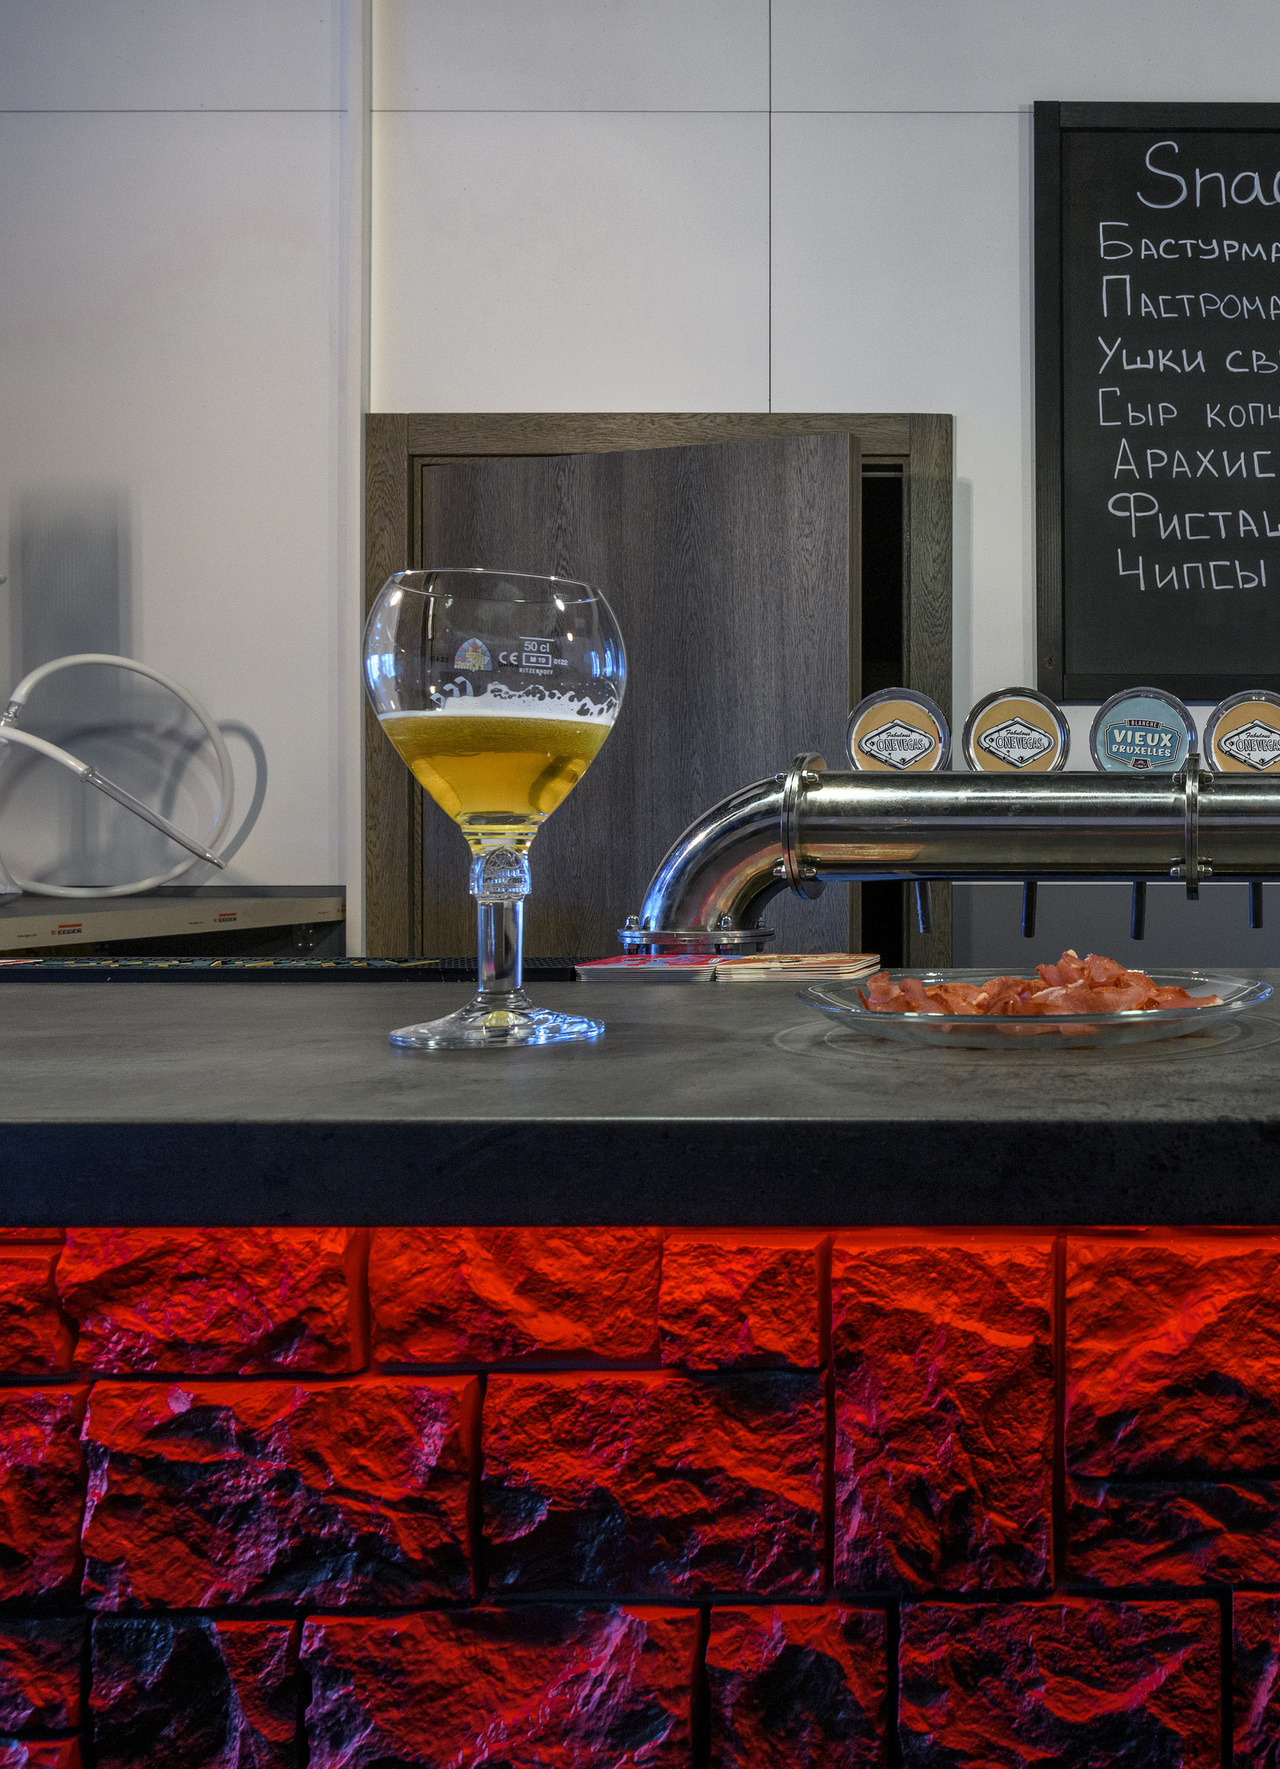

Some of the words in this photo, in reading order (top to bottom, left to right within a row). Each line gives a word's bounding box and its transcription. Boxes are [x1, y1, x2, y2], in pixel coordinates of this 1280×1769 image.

[524, 641, 538, 652] 50
[540, 643, 550, 653] cl
[553, 658, 569, 666] 0122
[1113, 729, 1173, 747] VIEUX
[1112, 744, 1171, 757] BRUXELLES
